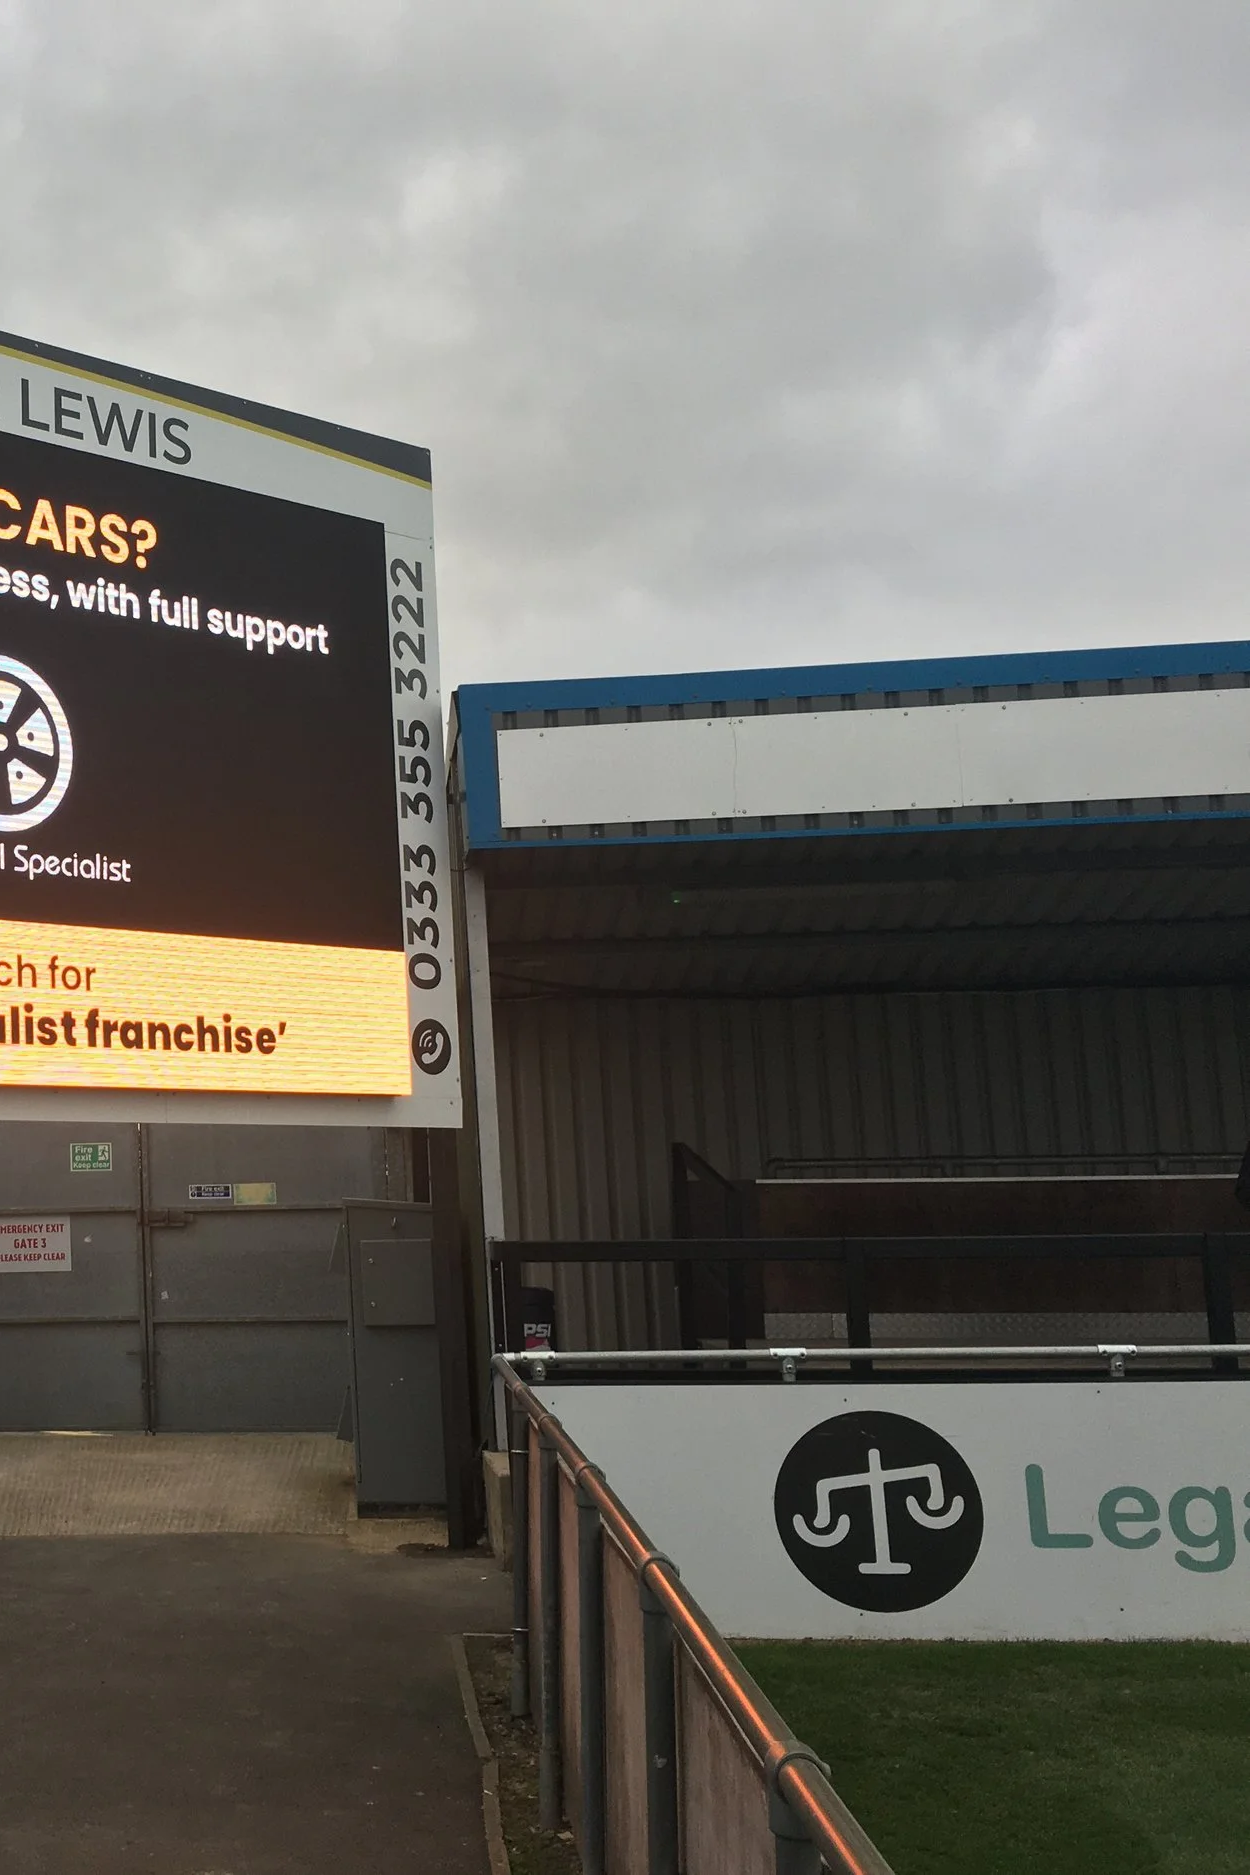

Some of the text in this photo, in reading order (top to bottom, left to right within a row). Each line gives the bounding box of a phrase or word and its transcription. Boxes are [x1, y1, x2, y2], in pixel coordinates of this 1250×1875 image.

[21, 378, 193, 466] LEWIS
[66, 577, 141, 620] with
[148, 589, 199, 631] full
[207, 607, 330, 655] support
[390, 556, 442, 990] 0333 355 3222
[13, 844, 132, 883] Specialist
[48, 954, 97, 992] for
[75, 1145, 93, 1154] Fire
[75, 1153, 92, 1162] exit
[73, 1161, 110, 1171] Keep clear
[45, 1223, 65, 1233] EXIT
[13, 1238, 47, 1249] GATE 3
[23, 1252, 42, 1261] KEEP
[43, 1252, 66, 1261] CLEAR
[1024, 1463, 1250, 1573] Leg
